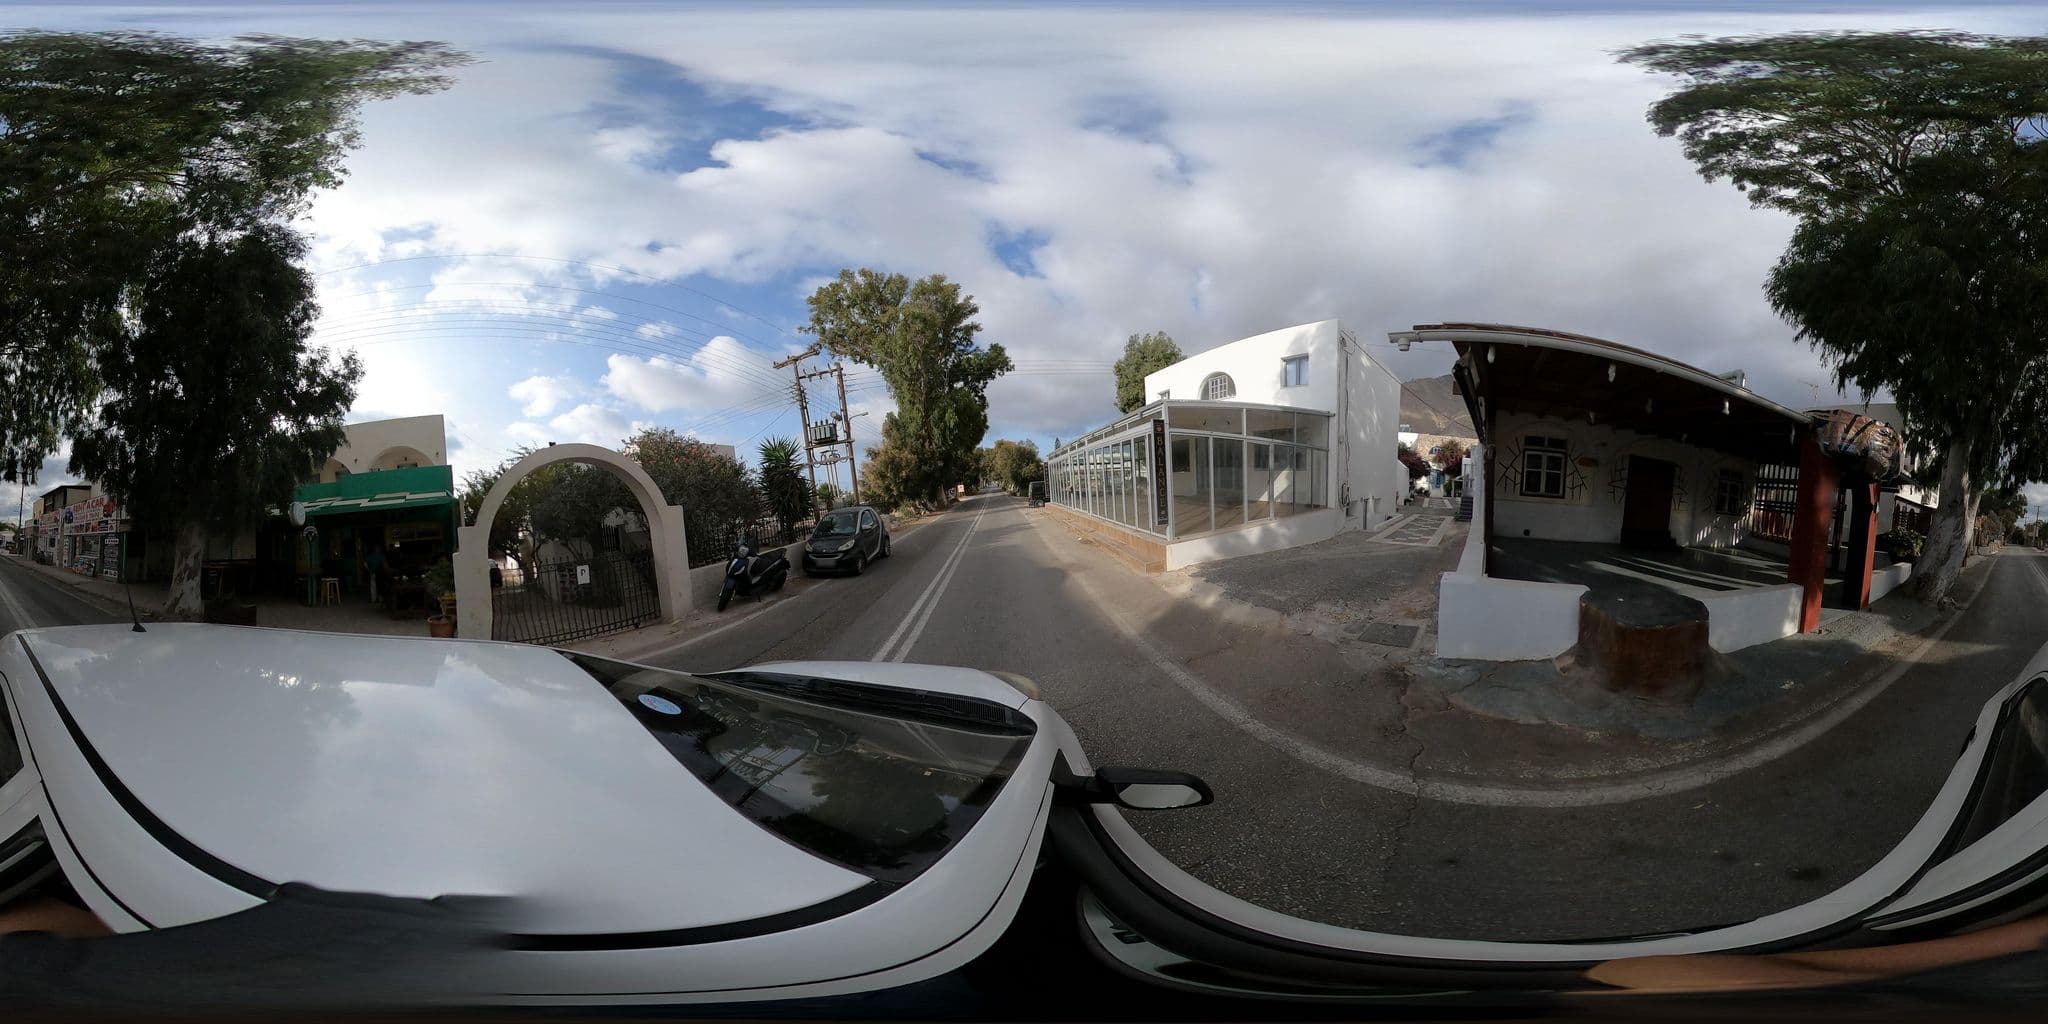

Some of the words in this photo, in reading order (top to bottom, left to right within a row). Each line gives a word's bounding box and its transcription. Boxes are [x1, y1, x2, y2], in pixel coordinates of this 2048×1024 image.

[1156, 436, 1166, 506] BALANCE
[73, 502, 86, 512] RENT
[91, 497, 104, 508] CAR
